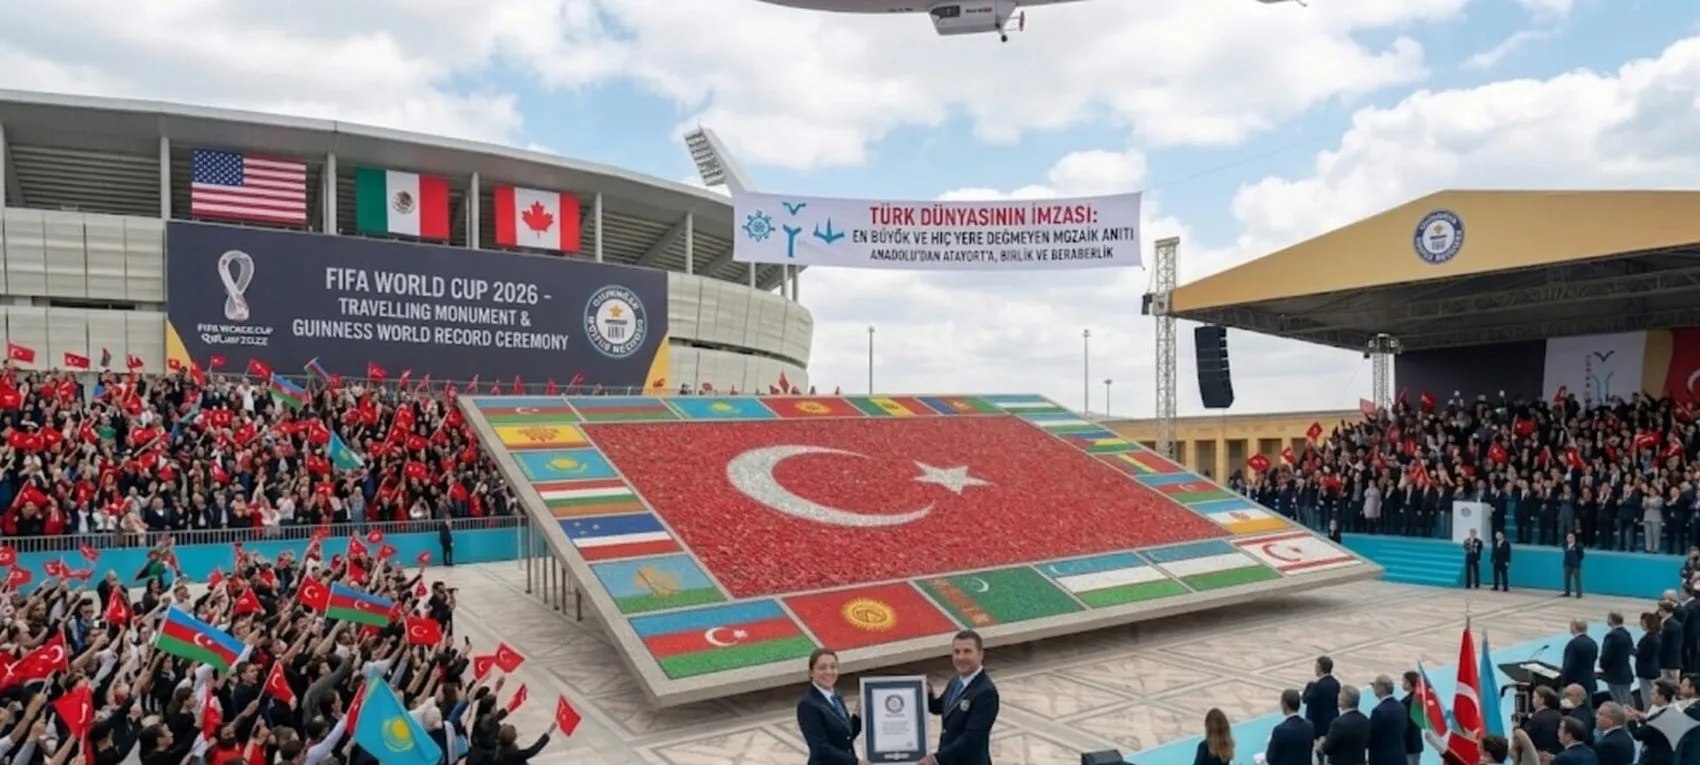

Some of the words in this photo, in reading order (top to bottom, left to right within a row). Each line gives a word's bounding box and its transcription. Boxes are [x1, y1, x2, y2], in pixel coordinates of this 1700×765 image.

[869, 202, 915, 226] TÜRK
[921, 203, 1025, 226] DÜNYASININ
[852, 229, 867, 243] EN
[914, 231, 928, 245] VE
[953, 231, 983, 245] YERE
[1036, 249, 1049, 261] VE
[326, 267, 370, 293] FIFA
[374, 271, 445, 298] WORLD
[451, 278, 488, 300] CUP
[493, 281, 538, 305] 2026
[338, 297, 431, 320] TRAVELLING
[434, 305, 517, 326] MONUMENT
[520, 310, 532, 327] &
[292, 318, 373, 340] GUINNESS
[376, 323, 431, 343] WORLD
[434, 327, 492, 347] RECORD
[495, 330, 569, 351] CEREMONY
